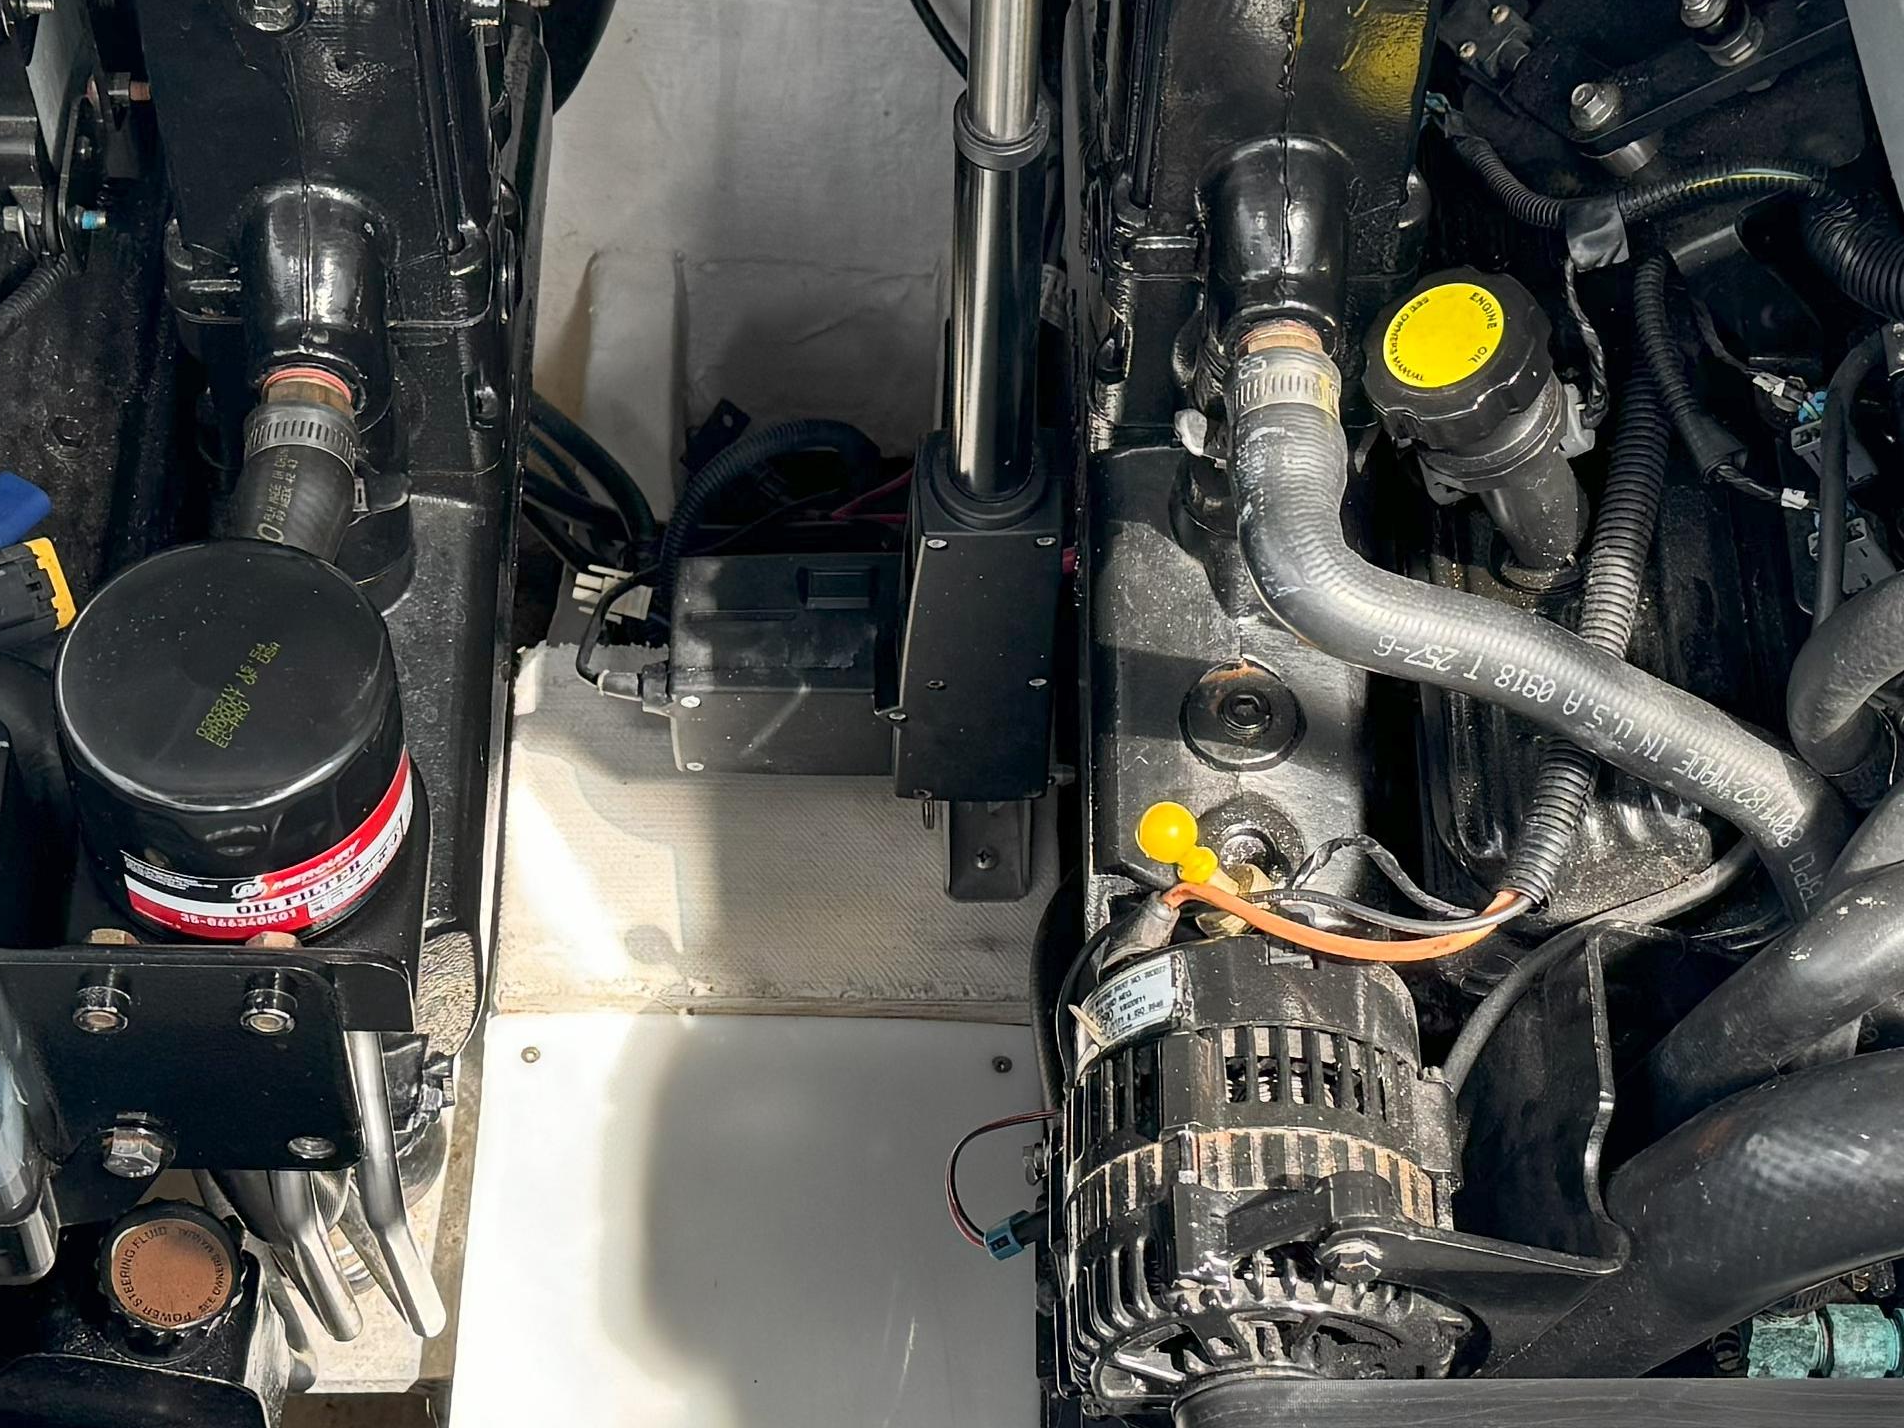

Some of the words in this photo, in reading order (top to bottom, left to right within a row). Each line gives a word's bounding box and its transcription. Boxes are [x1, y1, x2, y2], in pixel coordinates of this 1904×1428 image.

[1469, 290, 1498, 330] ENGINE
[1468, 345, 1488, 365] OIL
[1373, 633, 1462, 673] 257-6
[1462, 654, 1485, 680] T
[204, 688, 245, 744] PRODUCT
[245, 667, 258, 688] OF
[259, 641, 282, 666] USA
[1493, 662, 1557, 703] 0918
[1562, 688, 1636, 750] U.S.A
[1639, 733, 1673, 763] IN
[1672, 746, 1734, 796] MADE
[269, 838, 361, 892] MERCURY
[235, 898, 277, 916] OIL
[282, 859, 362, 908] FILTER
[133, 1225, 169, 1250] FLUID
[120, 1246, 144, 1307] STEERING
[141, 1302, 193, 1325] POWER
